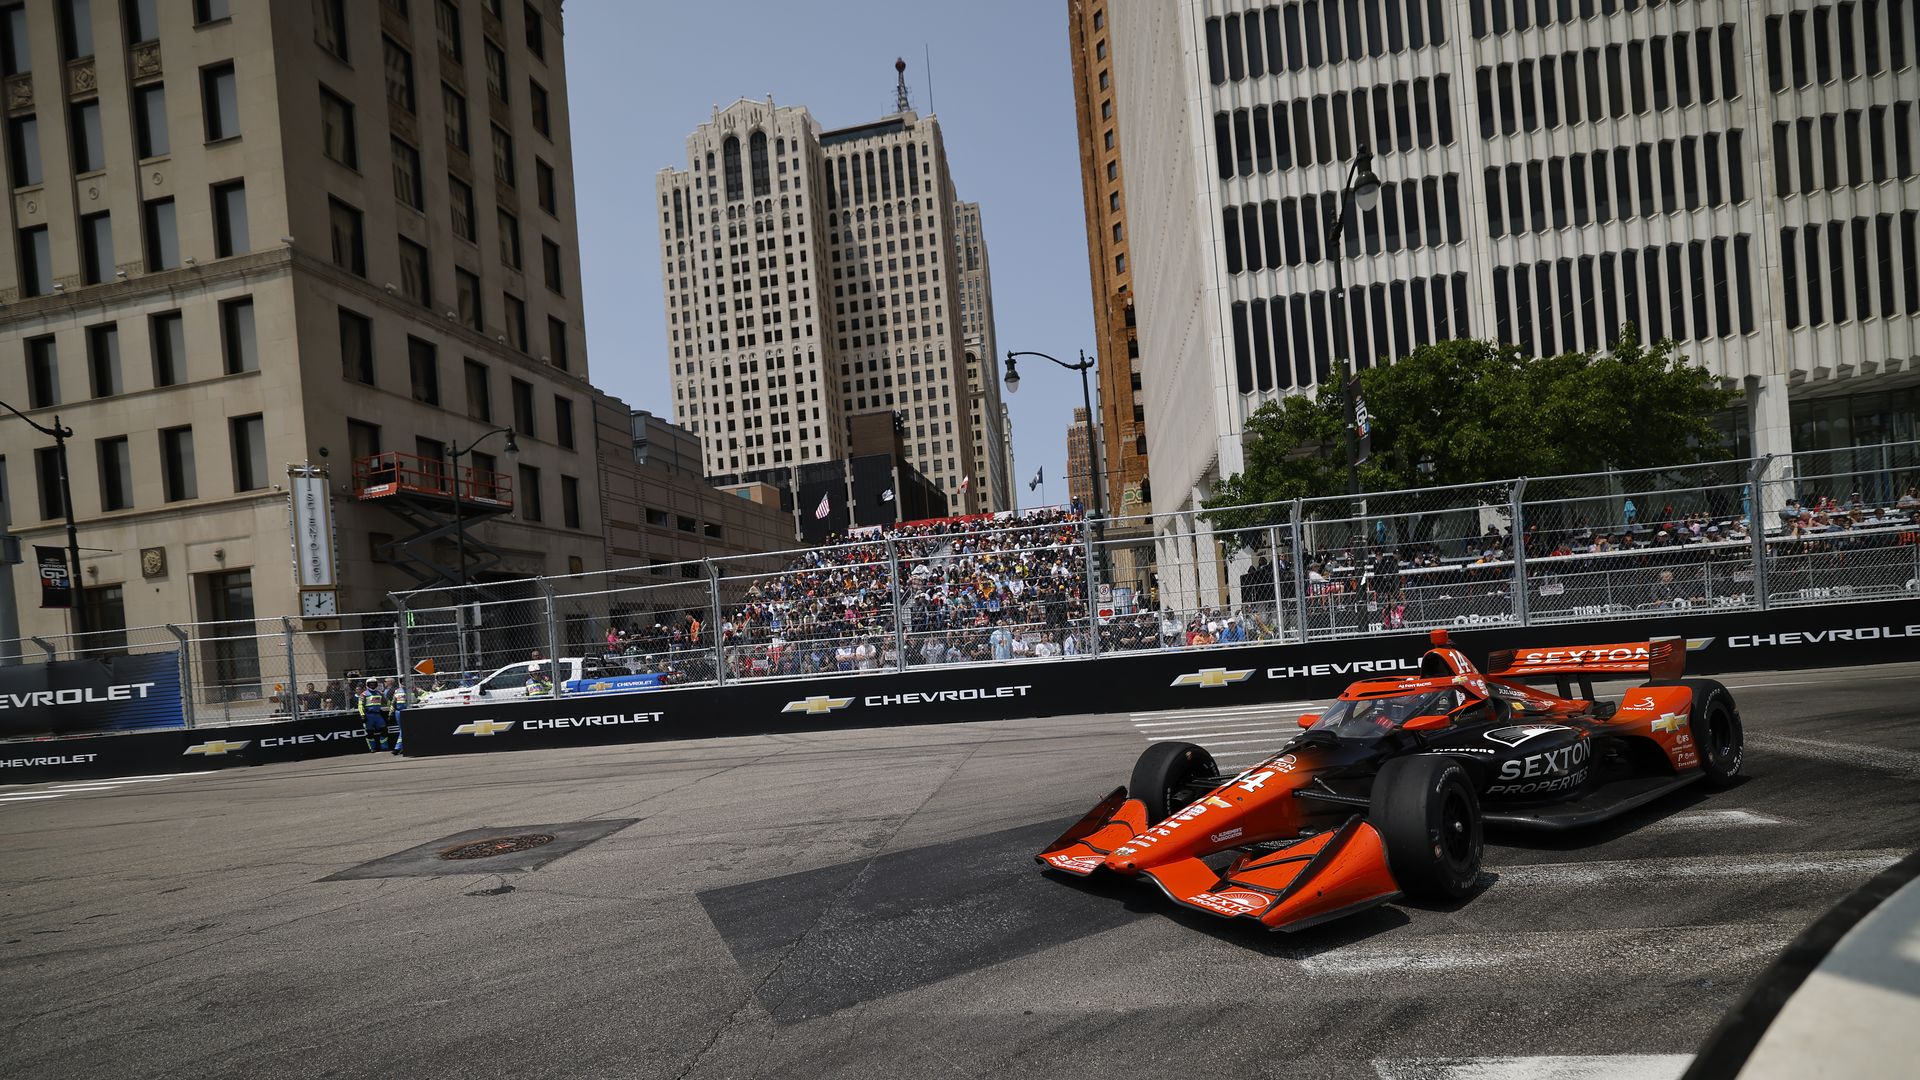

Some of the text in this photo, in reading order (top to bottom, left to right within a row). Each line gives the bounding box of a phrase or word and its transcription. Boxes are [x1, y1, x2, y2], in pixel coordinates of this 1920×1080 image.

[1728, 625, 1920, 648] CHEVROLE
[1449, 650, 1471, 675] 14
[1525, 648, 1650, 665] SEXTON
[1267, 658, 1424, 679] CHEVROL
[865, 685, 1032, 707] CHEVROLET
[523, 711, 664, 730] CHEVROLET
[260, 724, 401, 748] CHEVROE
[0, 753, 97, 768] HEVROLET
[1498, 737, 1591, 781] SEXTON
[1486, 767, 1589, 795] PROPERTIES
